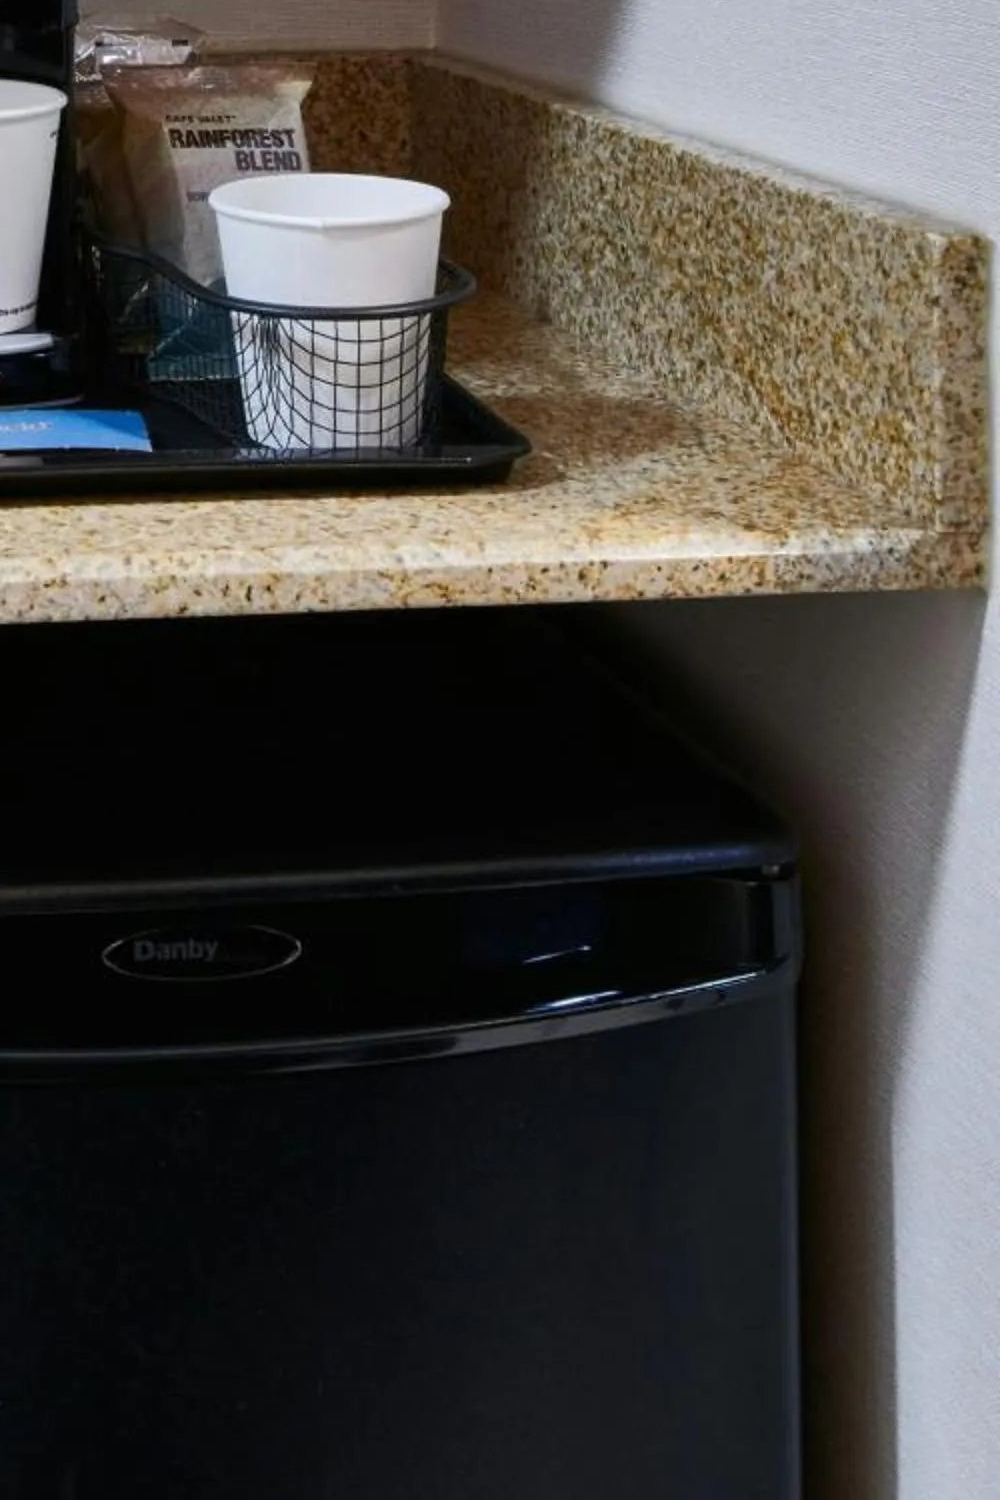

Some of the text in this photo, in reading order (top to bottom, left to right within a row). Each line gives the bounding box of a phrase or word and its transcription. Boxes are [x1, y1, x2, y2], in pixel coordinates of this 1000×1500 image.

[168, 128, 296, 149] RAINFOREST
[235, 150, 302, 172] BLEND
[133, 938, 218, 962] Danby
